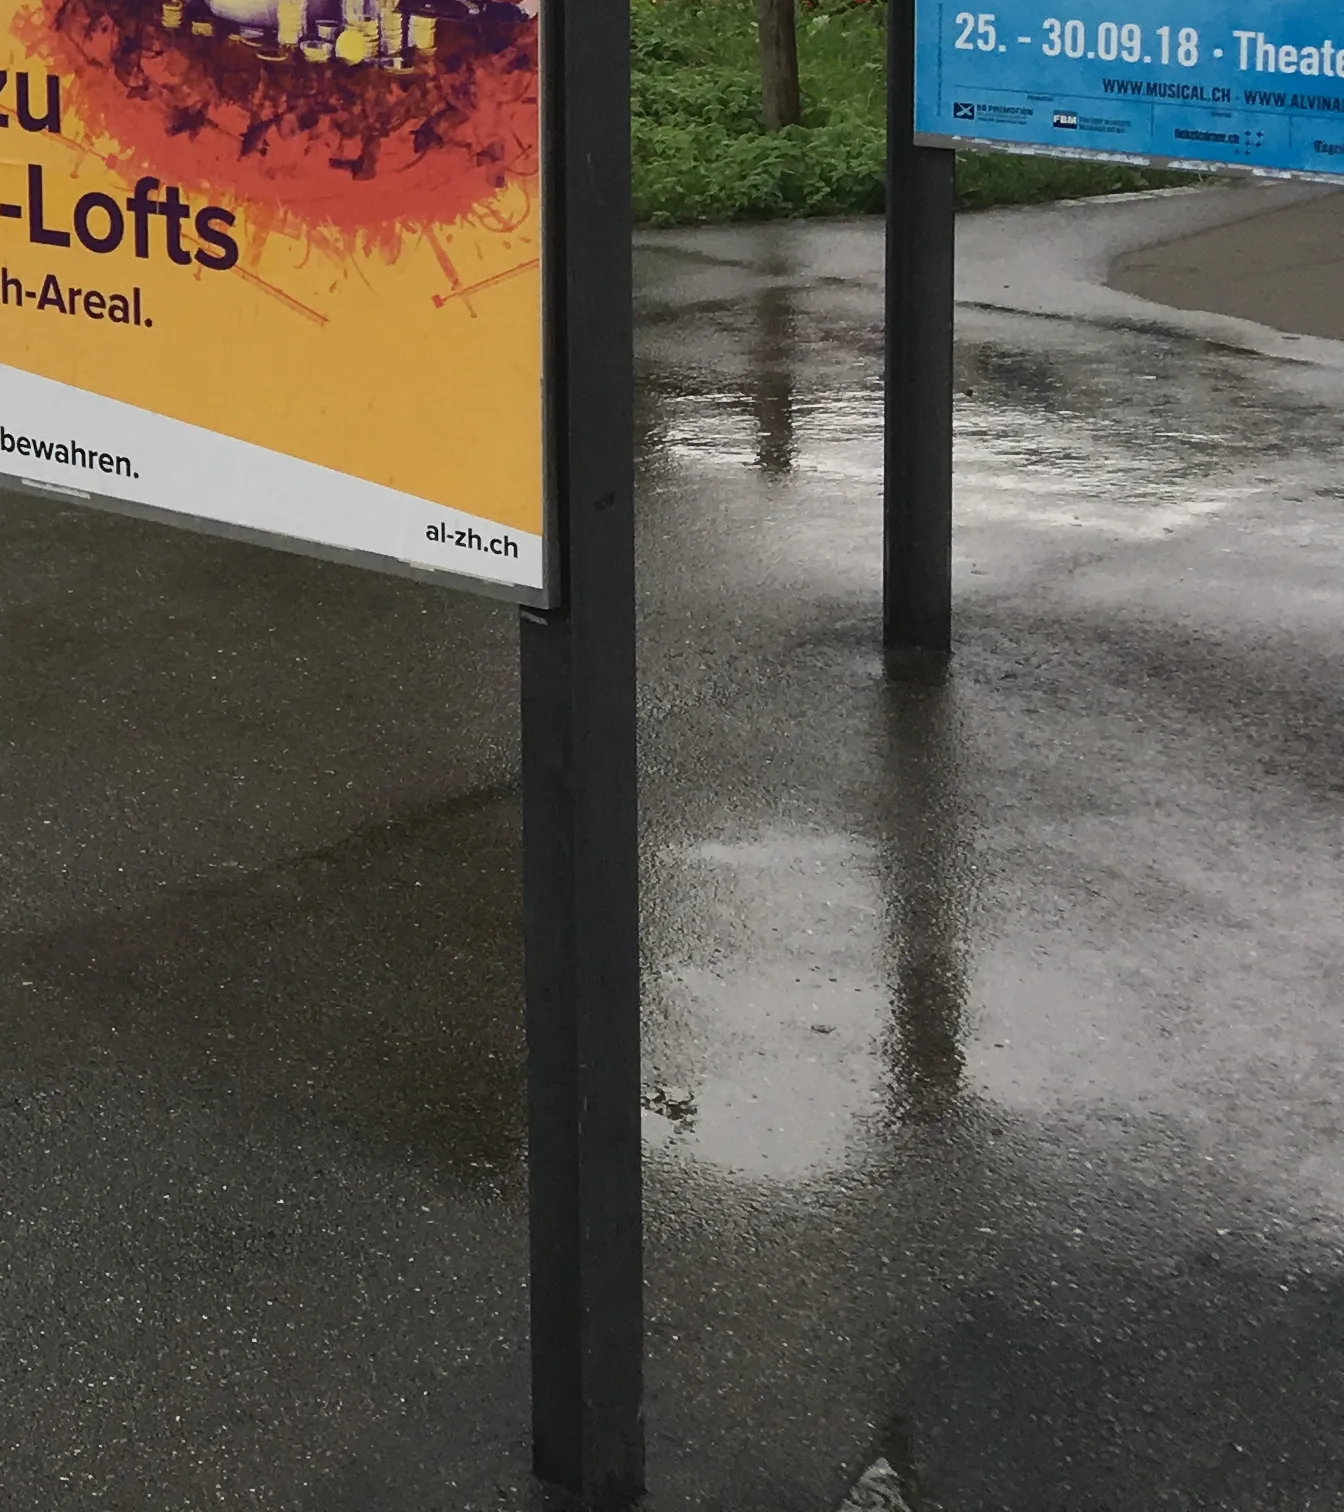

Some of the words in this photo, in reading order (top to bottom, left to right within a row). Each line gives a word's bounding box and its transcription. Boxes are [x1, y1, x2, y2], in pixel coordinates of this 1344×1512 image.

[954, 11, 1007, 54] 25.
[1042, 18, 1200, 68] 30.09.18
[1102, 79, 1231, 103] WWW.MUSICAL.CH
[0, 425, 140, 479] bewahren.
[425, 522, 519, 559] al-zh.ch
